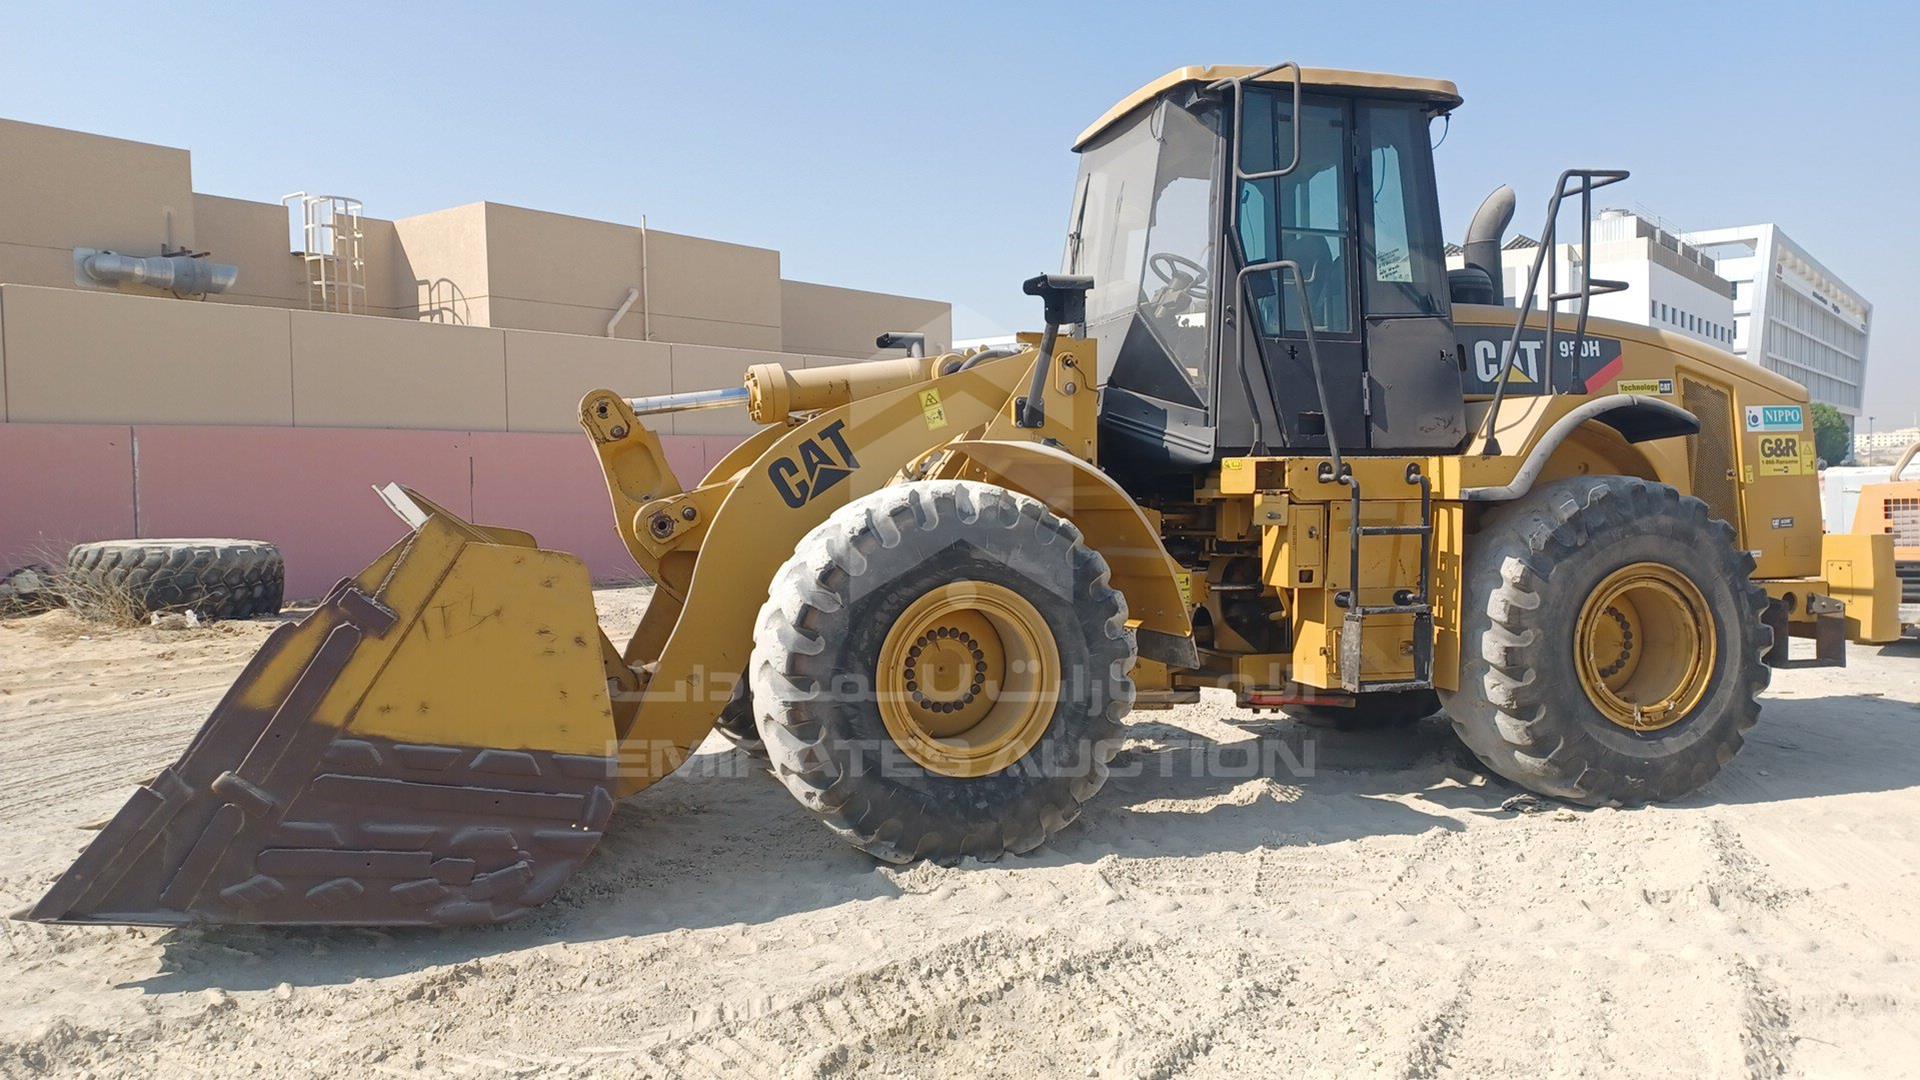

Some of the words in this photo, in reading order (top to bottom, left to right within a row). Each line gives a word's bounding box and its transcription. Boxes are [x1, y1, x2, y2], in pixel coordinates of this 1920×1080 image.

[1474, 340, 1541, 383] CAT
[1559, 340, 1600, 357] 950H
[1621, 383, 1658, 392] Technology
[1765, 409, 1800, 422] NIPPO
[1761, 438, 1798, 458] G&R
[768, 418, 861, 508] CAT
